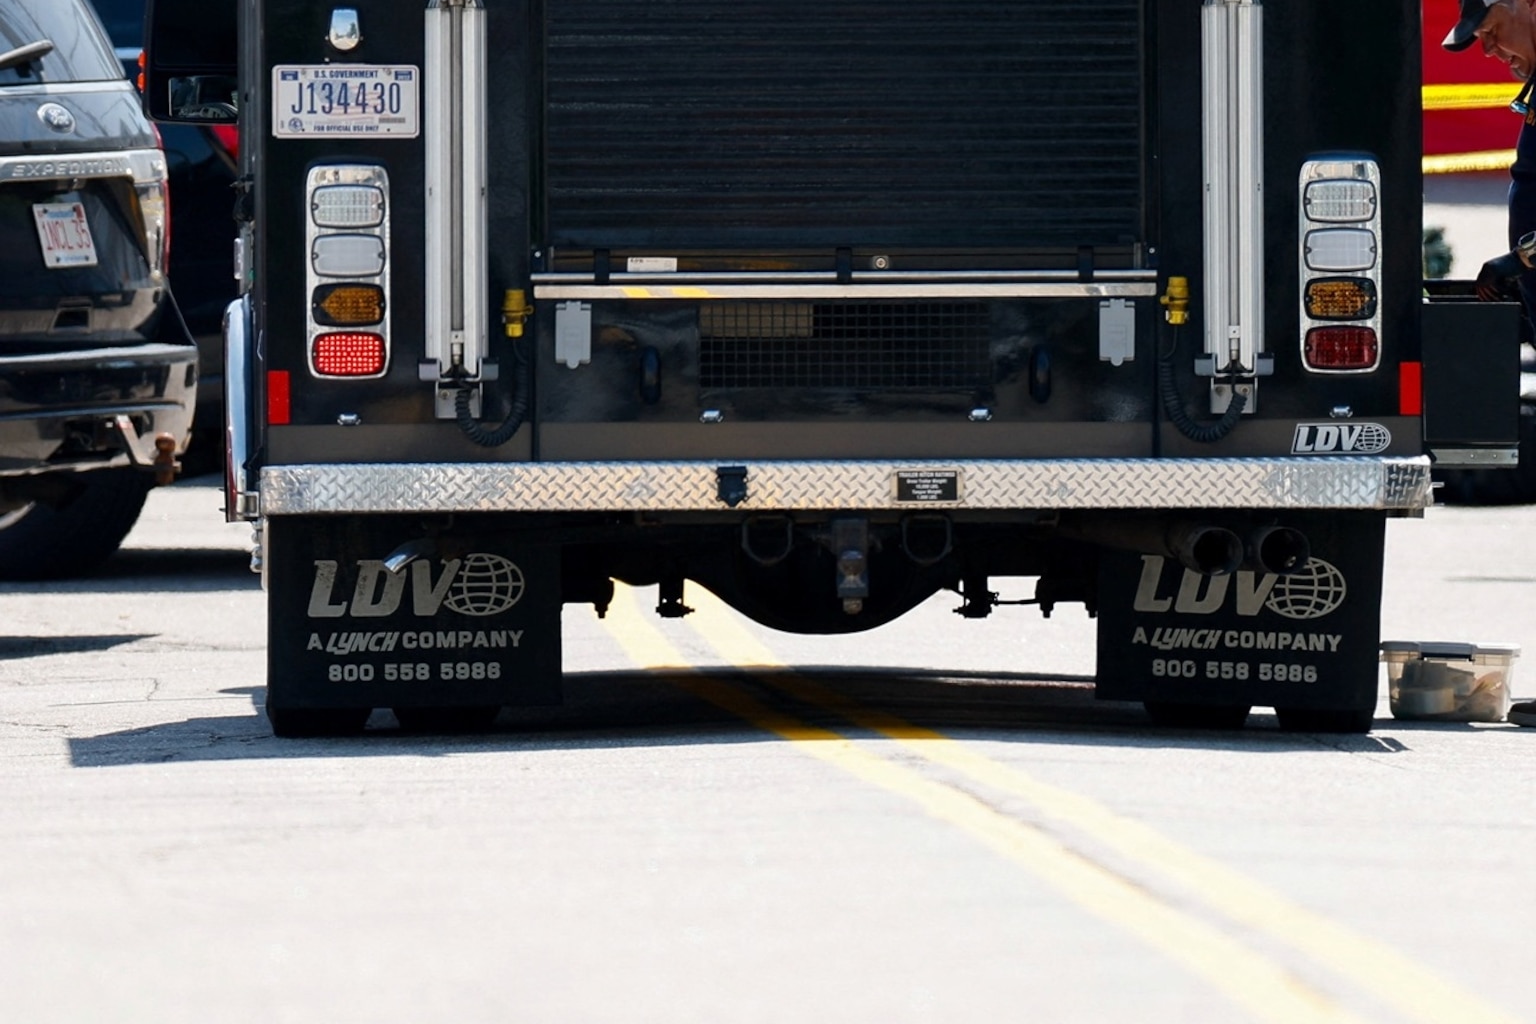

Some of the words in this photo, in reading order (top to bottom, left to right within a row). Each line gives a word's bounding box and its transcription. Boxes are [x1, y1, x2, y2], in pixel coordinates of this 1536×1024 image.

[314, 70, 327, 79] U.S.
[329, 70, 379, 79] GOVERNMENT
[291, 82, 401, 114] J134430
[326, 124, 352, 132] OFFICIAL
[12, 160, 125, 177] EXPEDITION
[71, 219, 91, 249] 35
[1295, 425, 1363, 452] LDV
[307, 558, 463, 618] LDV
[1133, 554, 1281, 617] LDV
[306, 632, 323, 651] A
[325, 631, 400, 656] LYNCH
[401, 629, 525, 650] COMPANY
[1131, 626, 1148, 645] A
[1150, 626, 1223, 651] LYNCH
[1223, 630, 1343, 653] COMPANY
[328, 663, 375, 682] 800
[383, 662, 431, 681] 558
[440, 661, 502, 680] 5986
[1152, 658, 1197, 678] 800
[1205, 660, 1250, 680] 558
[1258, 662, 1318, 684] 5986
